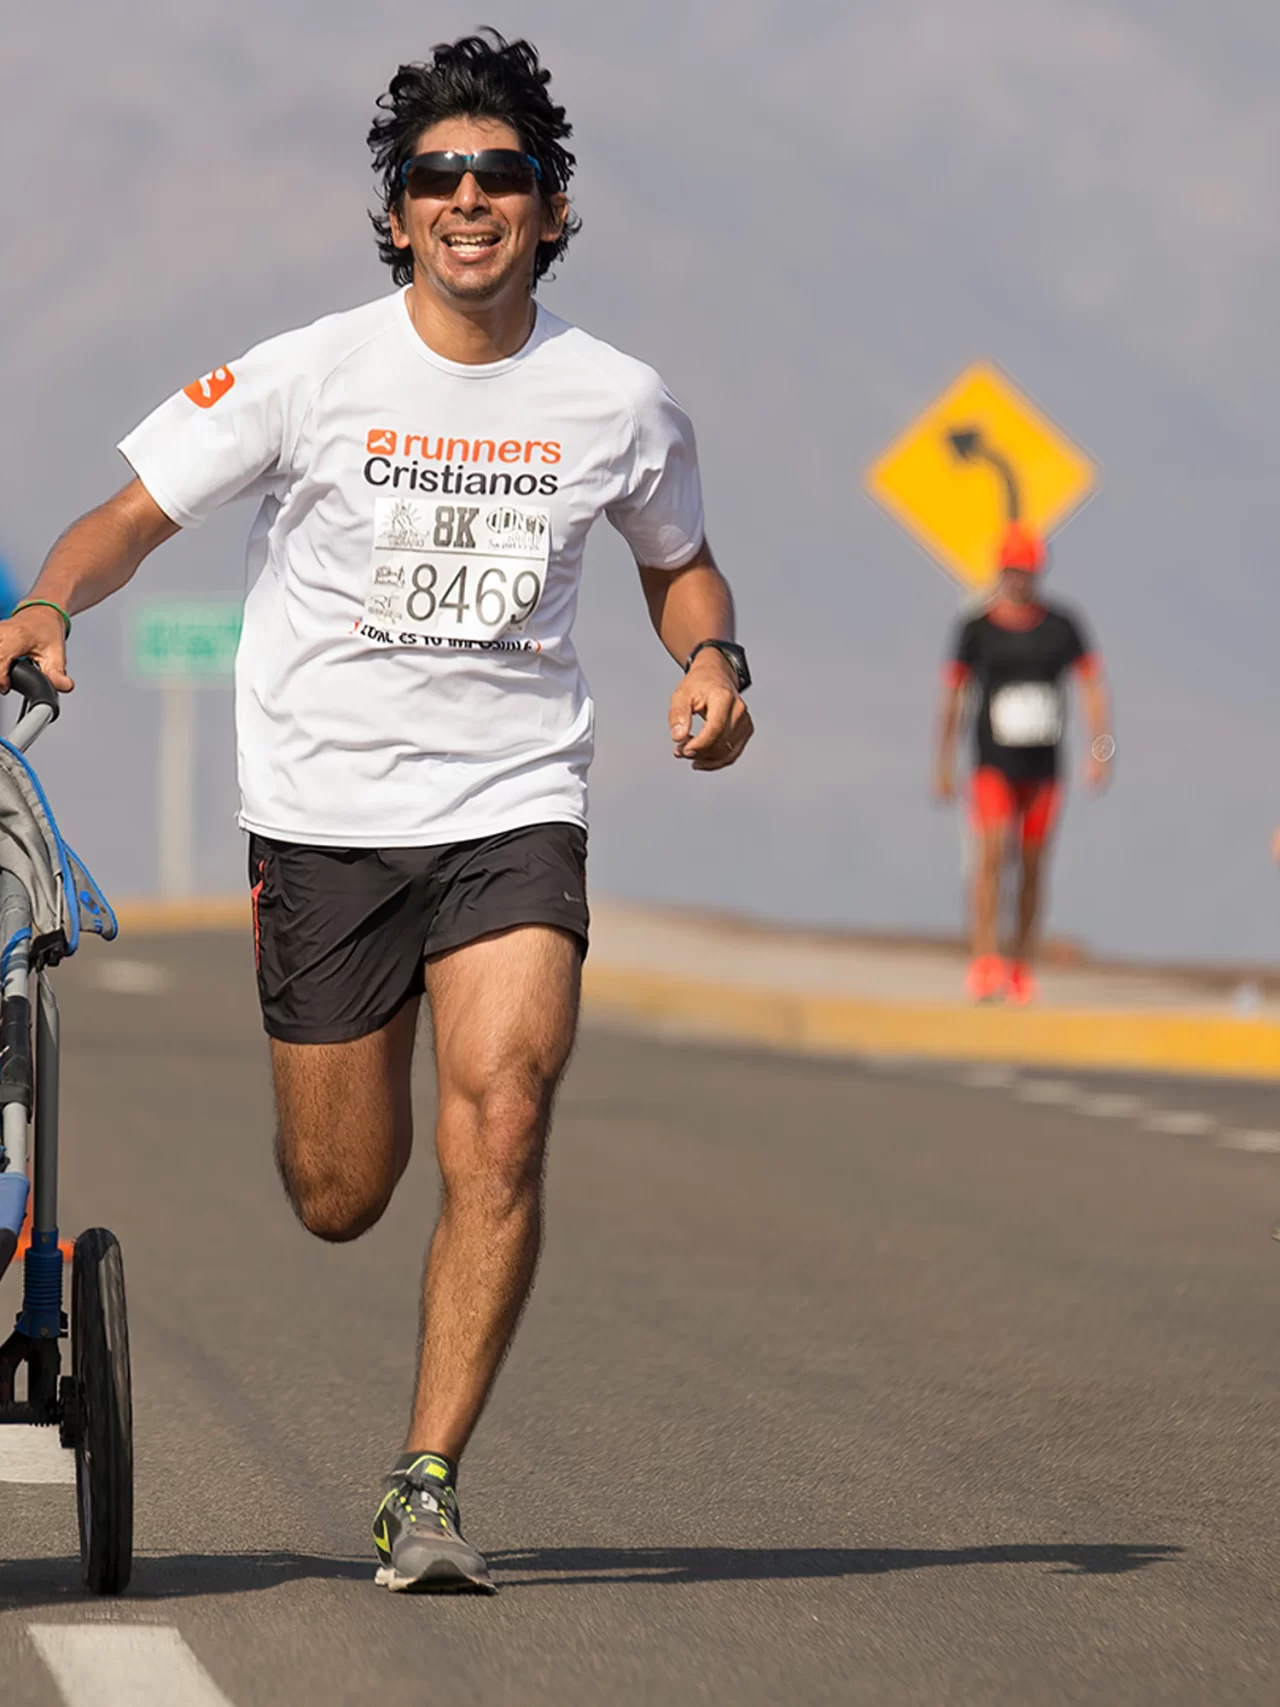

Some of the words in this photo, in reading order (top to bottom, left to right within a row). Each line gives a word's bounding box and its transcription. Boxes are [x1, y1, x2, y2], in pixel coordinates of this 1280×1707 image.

[403, 432, 562, 464] runners
[363, 456, 559, 496] Cristianos
[433, 505, 480, 549] 8K
[406, 562, 541, 627] 8469
